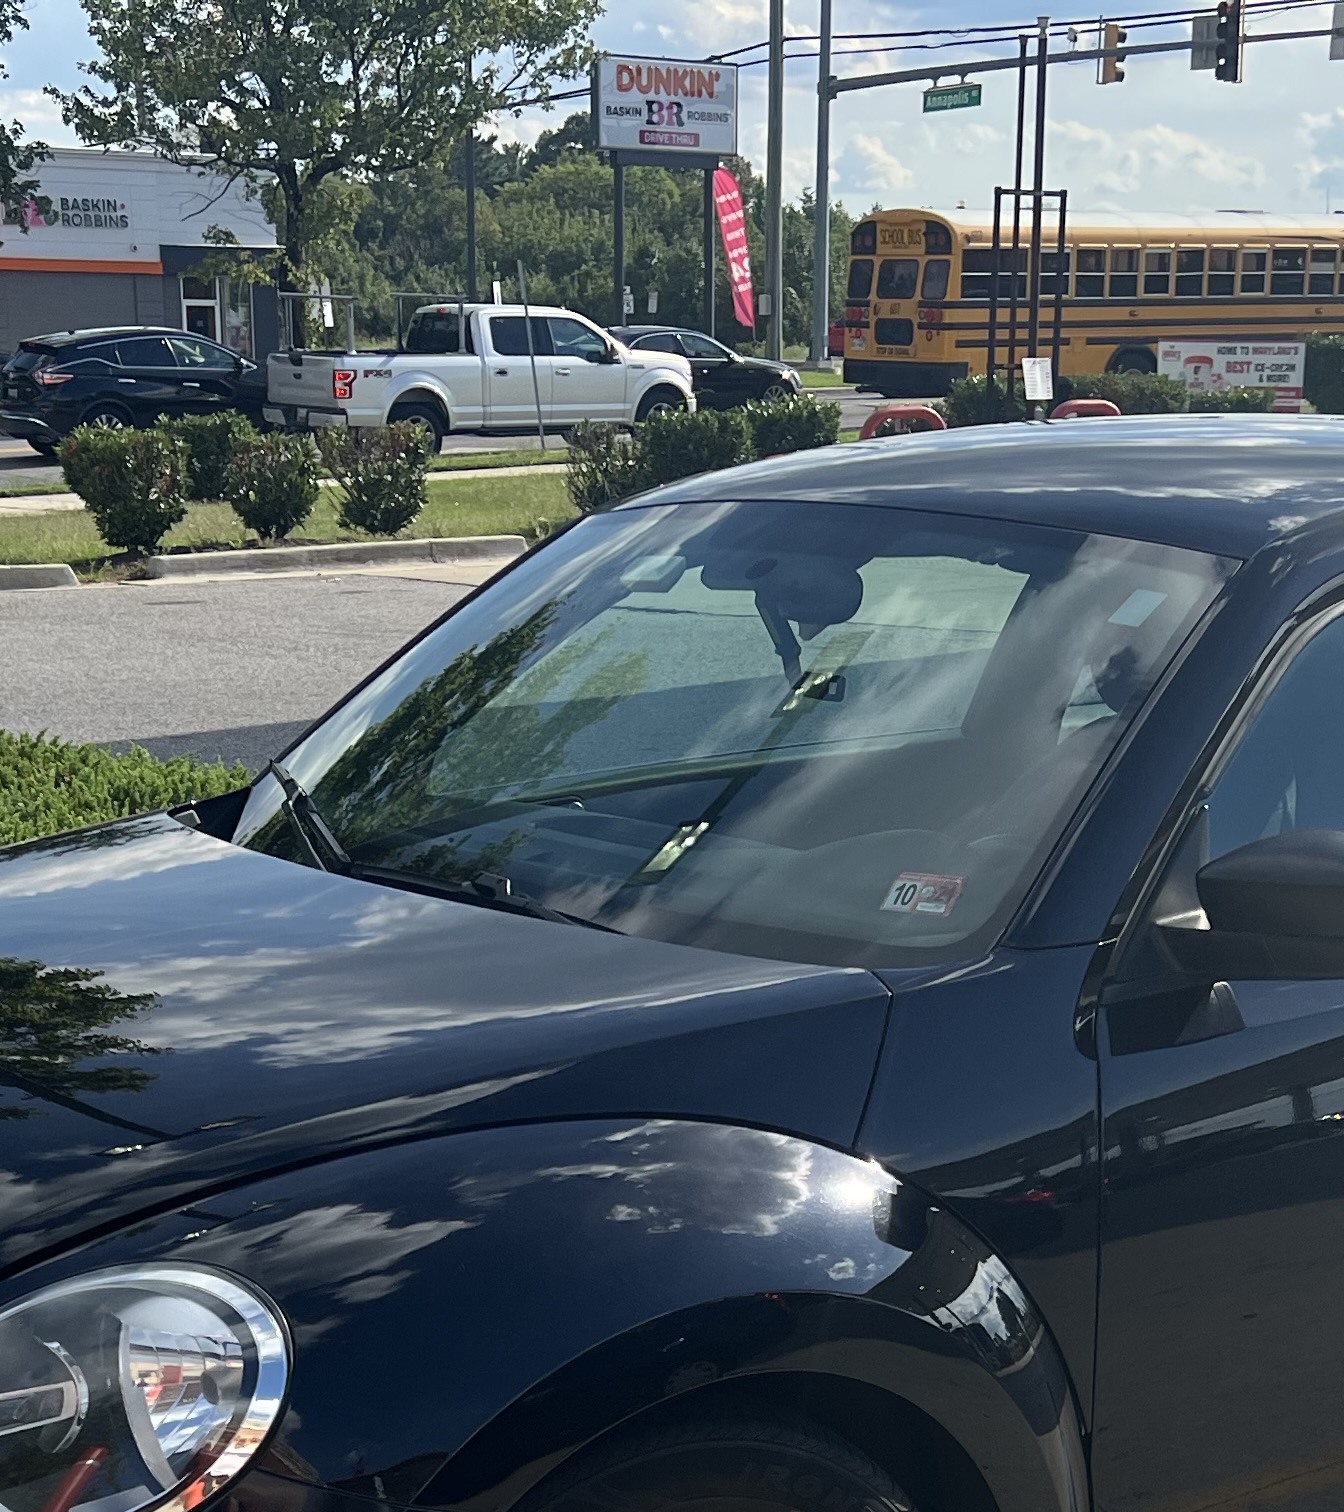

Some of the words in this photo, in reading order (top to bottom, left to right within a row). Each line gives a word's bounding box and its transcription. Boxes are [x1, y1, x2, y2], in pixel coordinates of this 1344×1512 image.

[616, 64, 721, 99] DUNKIN'
[926, 91, 969, 109] Annapolis
[606, 105, 642, 117] BASKIN
[687, 110, 730, 123] ROBBINS
[644, 132, 669, 143] DRIVE
[672, 134, 695, 145] THRU
[60, 197, 118, 213] BASKIN
[61, 213, 130, 228] ROBBINS
[880, 229, 906, 245] SCHOOL
[908, 229, 923, 245] BUS
[1217, 346, 1238, 355] HOME
[1240, 346, 1250, 355] TO
[363, 369, 393, 378] FX4
[1226, 361, 1253, 373] BEST
[893, 882, 918, 906] 10
